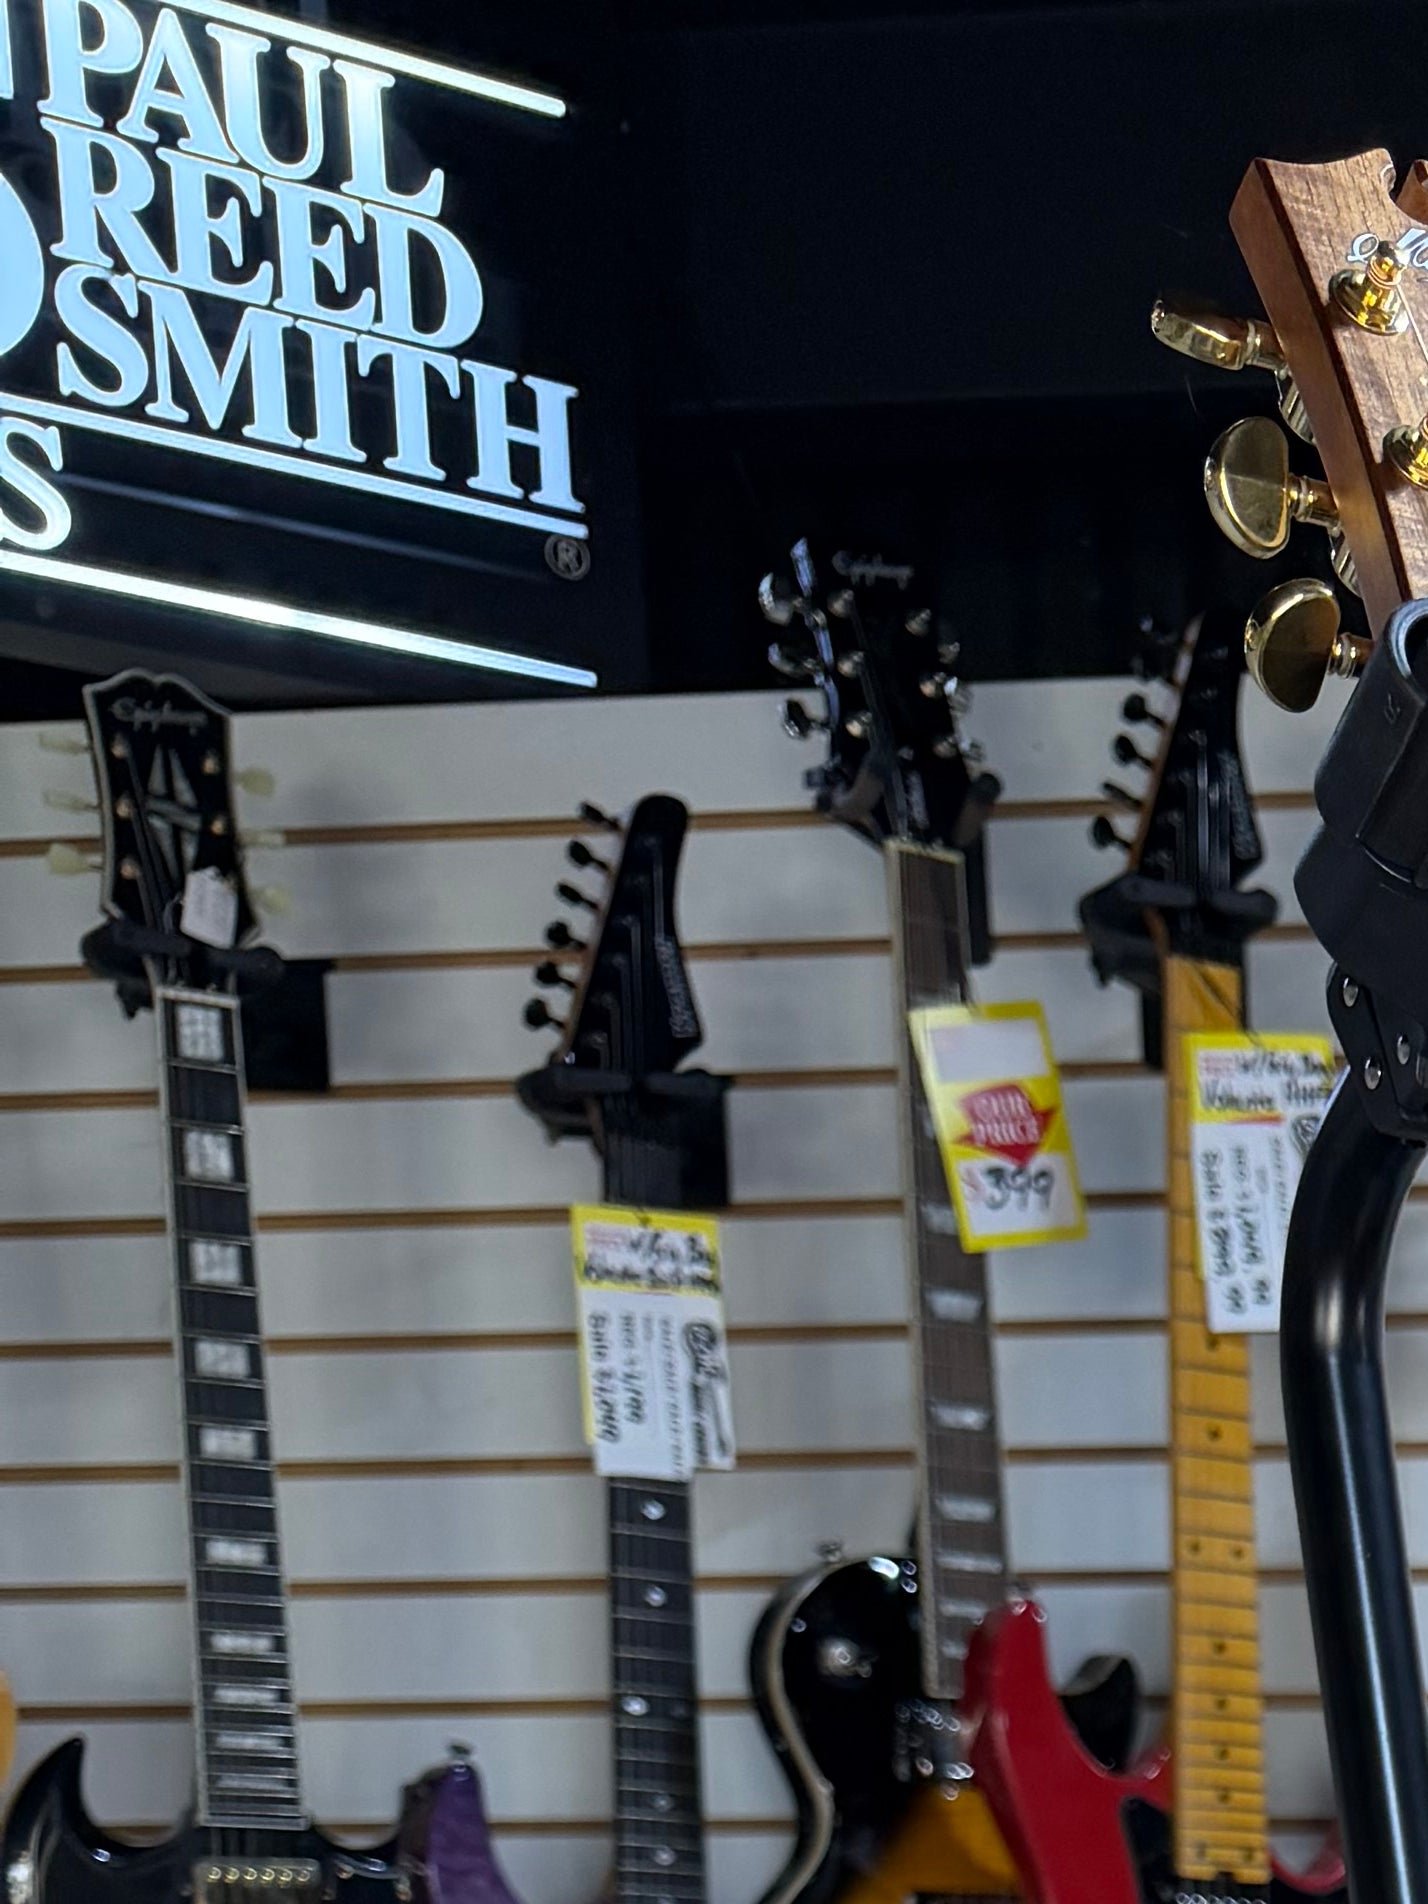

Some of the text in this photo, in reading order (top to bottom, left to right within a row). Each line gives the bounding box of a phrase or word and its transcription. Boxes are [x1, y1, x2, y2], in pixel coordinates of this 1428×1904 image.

[38, 0, 444, 217] PAUL
[40, 116, 483, 349] REED
[54, 263, 586, 513] SMITH
